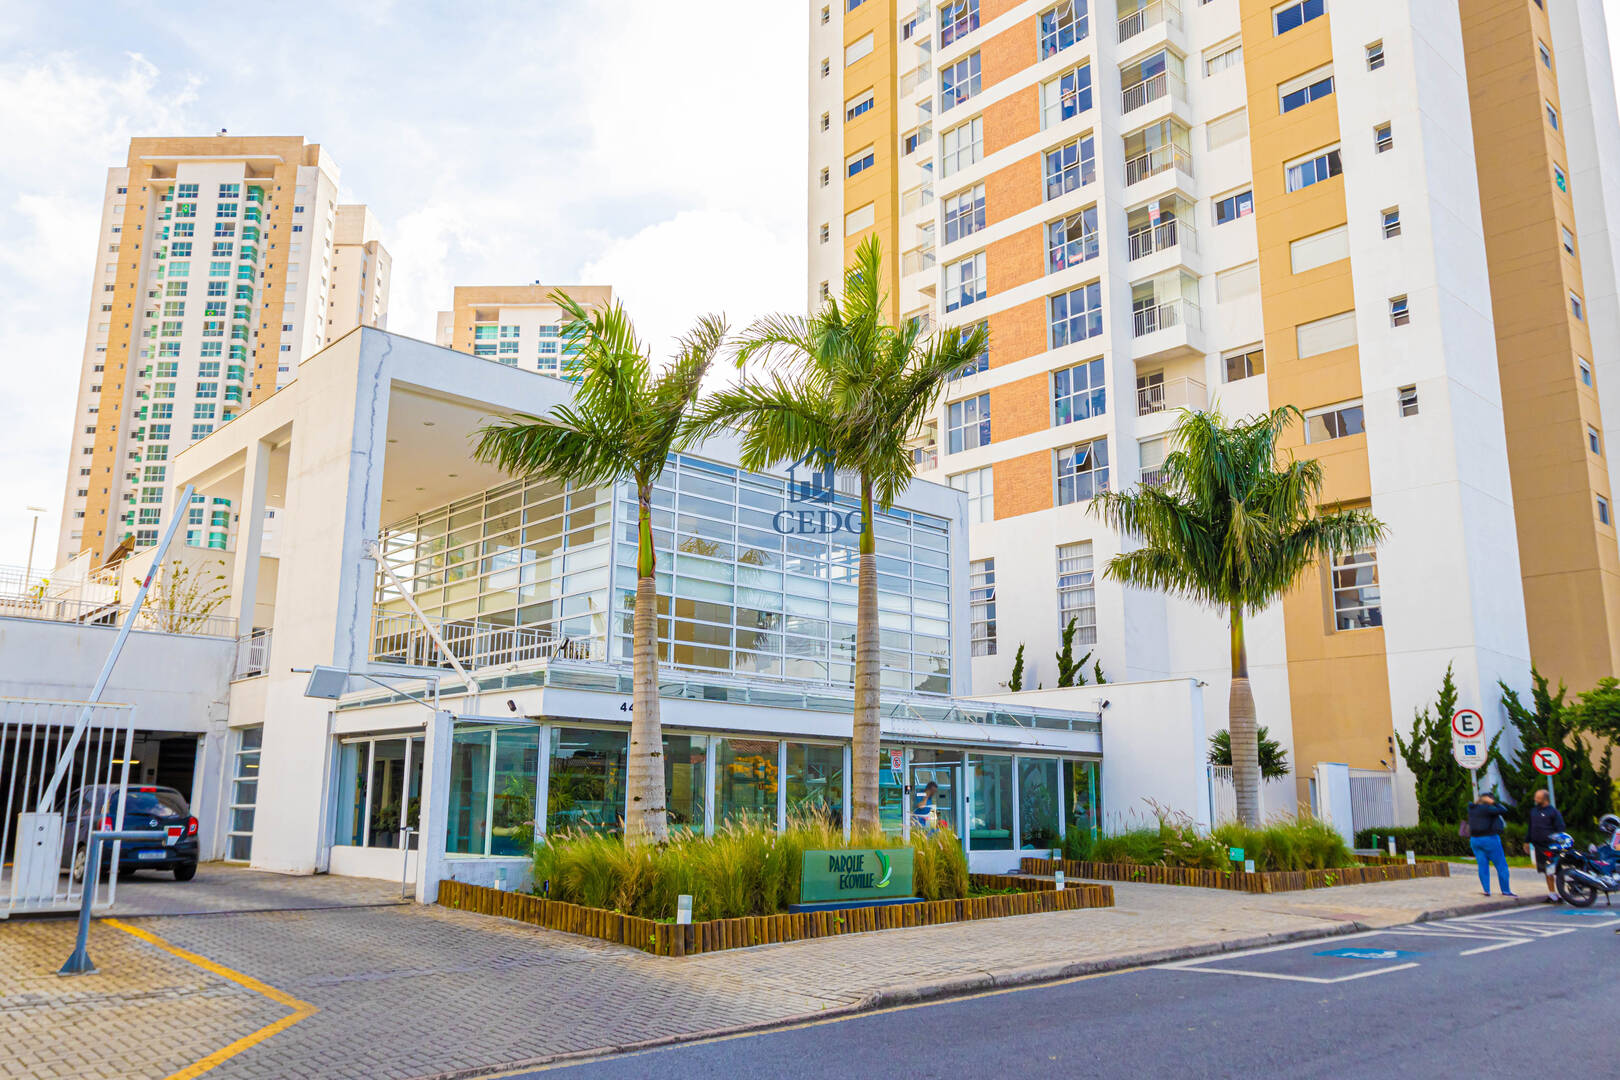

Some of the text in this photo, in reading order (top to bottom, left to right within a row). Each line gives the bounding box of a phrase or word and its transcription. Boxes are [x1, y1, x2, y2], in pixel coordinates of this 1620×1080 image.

[1461, 715, 1474, 731] E
[1541, 753, 1554, 769] E
[829, 854, 864, 873] PARQUE
[840, 873, 874, 889] ECOVILLE
